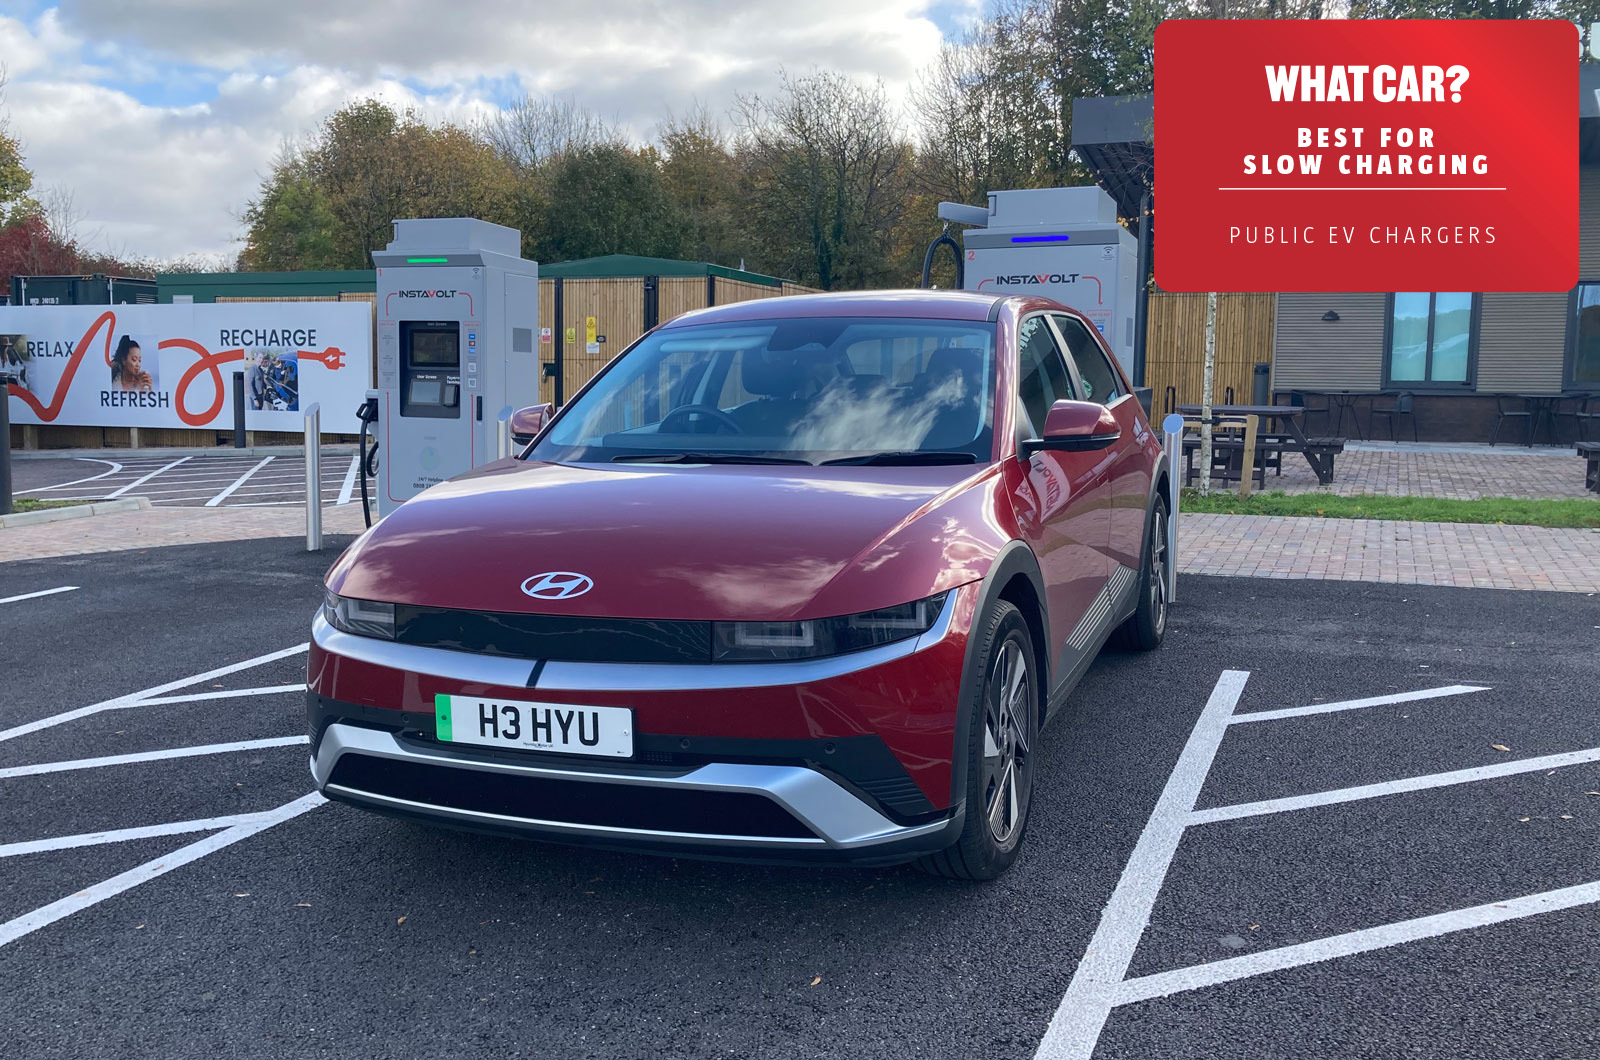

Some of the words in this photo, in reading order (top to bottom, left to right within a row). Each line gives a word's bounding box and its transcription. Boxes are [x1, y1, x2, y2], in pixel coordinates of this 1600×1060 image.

[967, 250, 975, 261] 2
[996, 273, 1080, 286] INSTAVOLT
[398, 289, 457, 299] INSTAVOLT
[220, 329, 317, 347] RECHARGE
[27, 341, 74, 358] RELAX
[100, 390, 169, 408] REFRESH
[478, 703, 521, 740] H3
[531, 707, 599, 746] HYU
